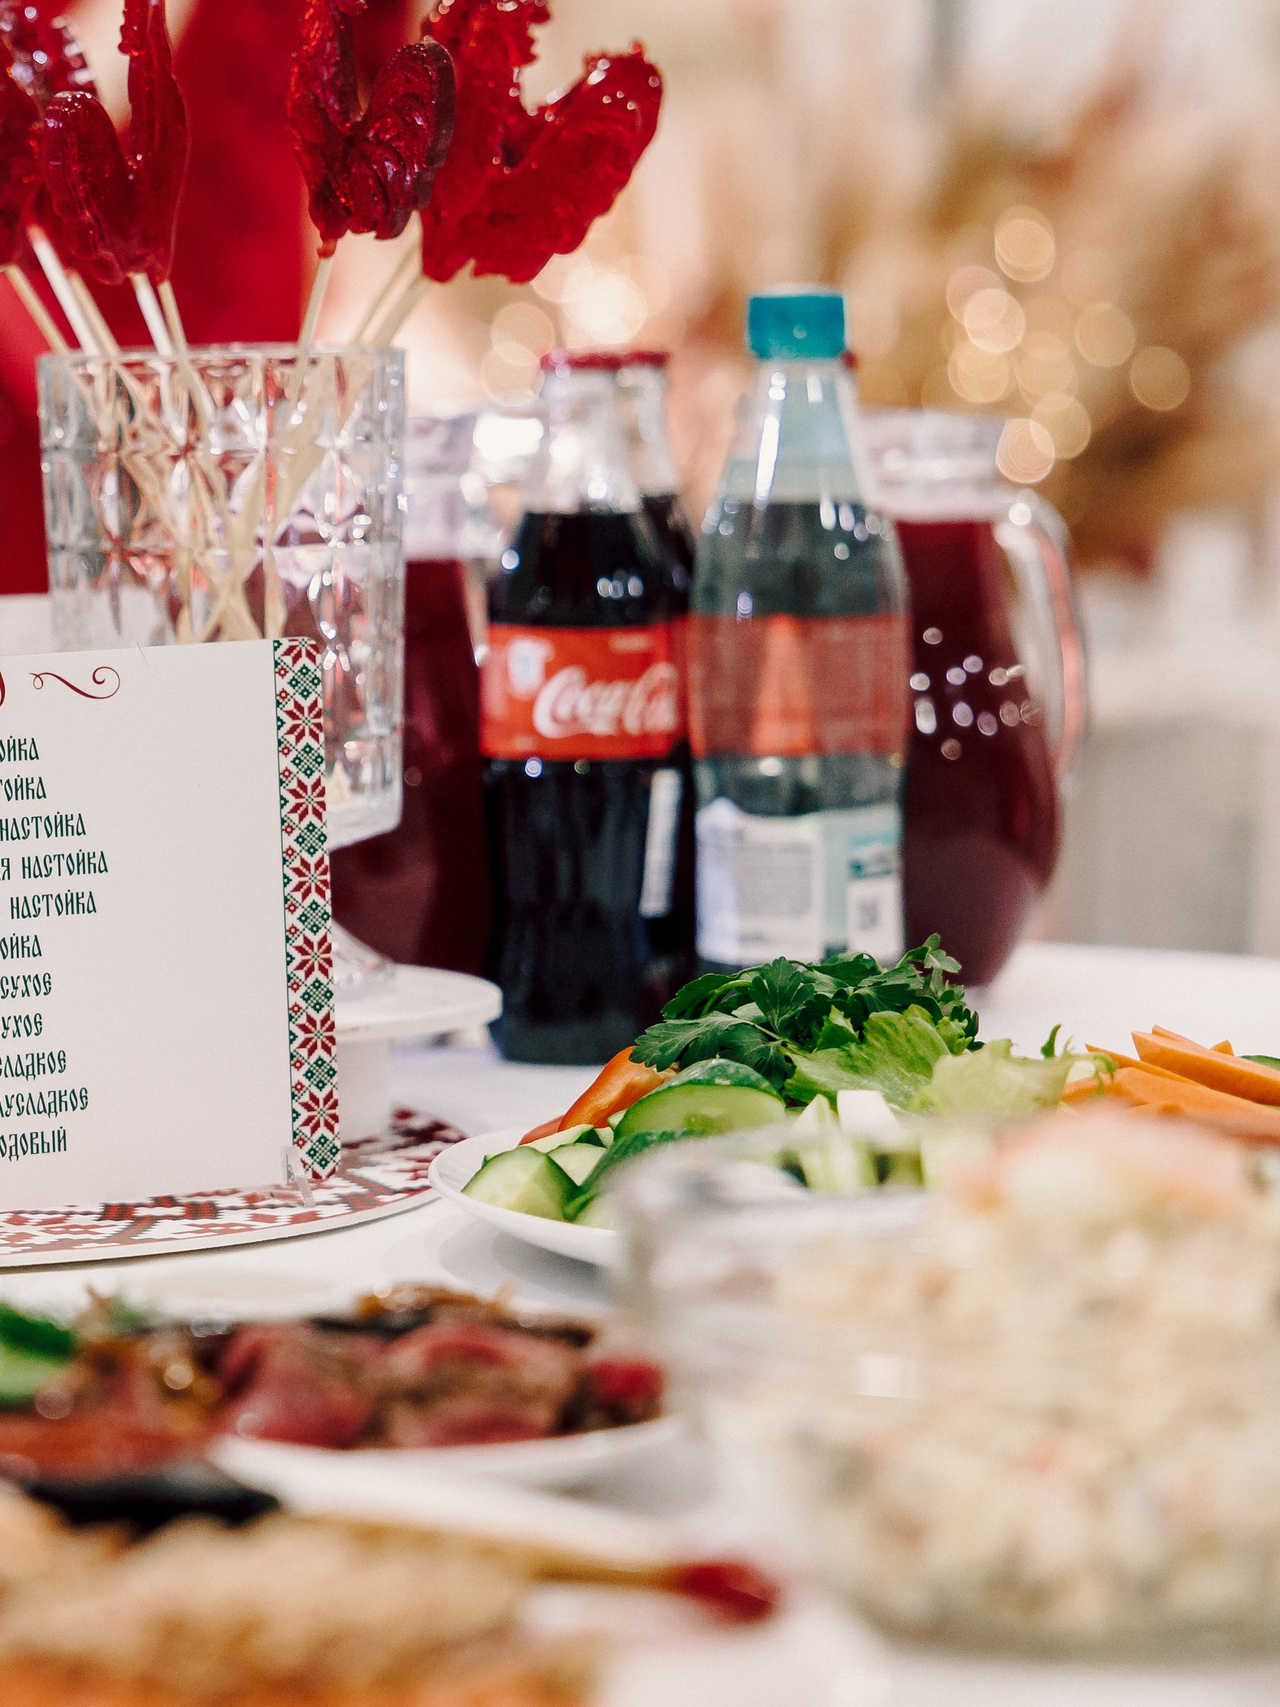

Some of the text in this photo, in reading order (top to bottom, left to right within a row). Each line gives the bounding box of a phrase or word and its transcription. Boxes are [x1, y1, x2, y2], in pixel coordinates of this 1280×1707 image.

[0, 811, 86, 841] НАСТОЙКА
[22, 849, 108, 879] НАСТОЙКА
[10, 889, 97, 920] НАСТОЙКА
[0, 972, 51, 999] СУХОЕ
